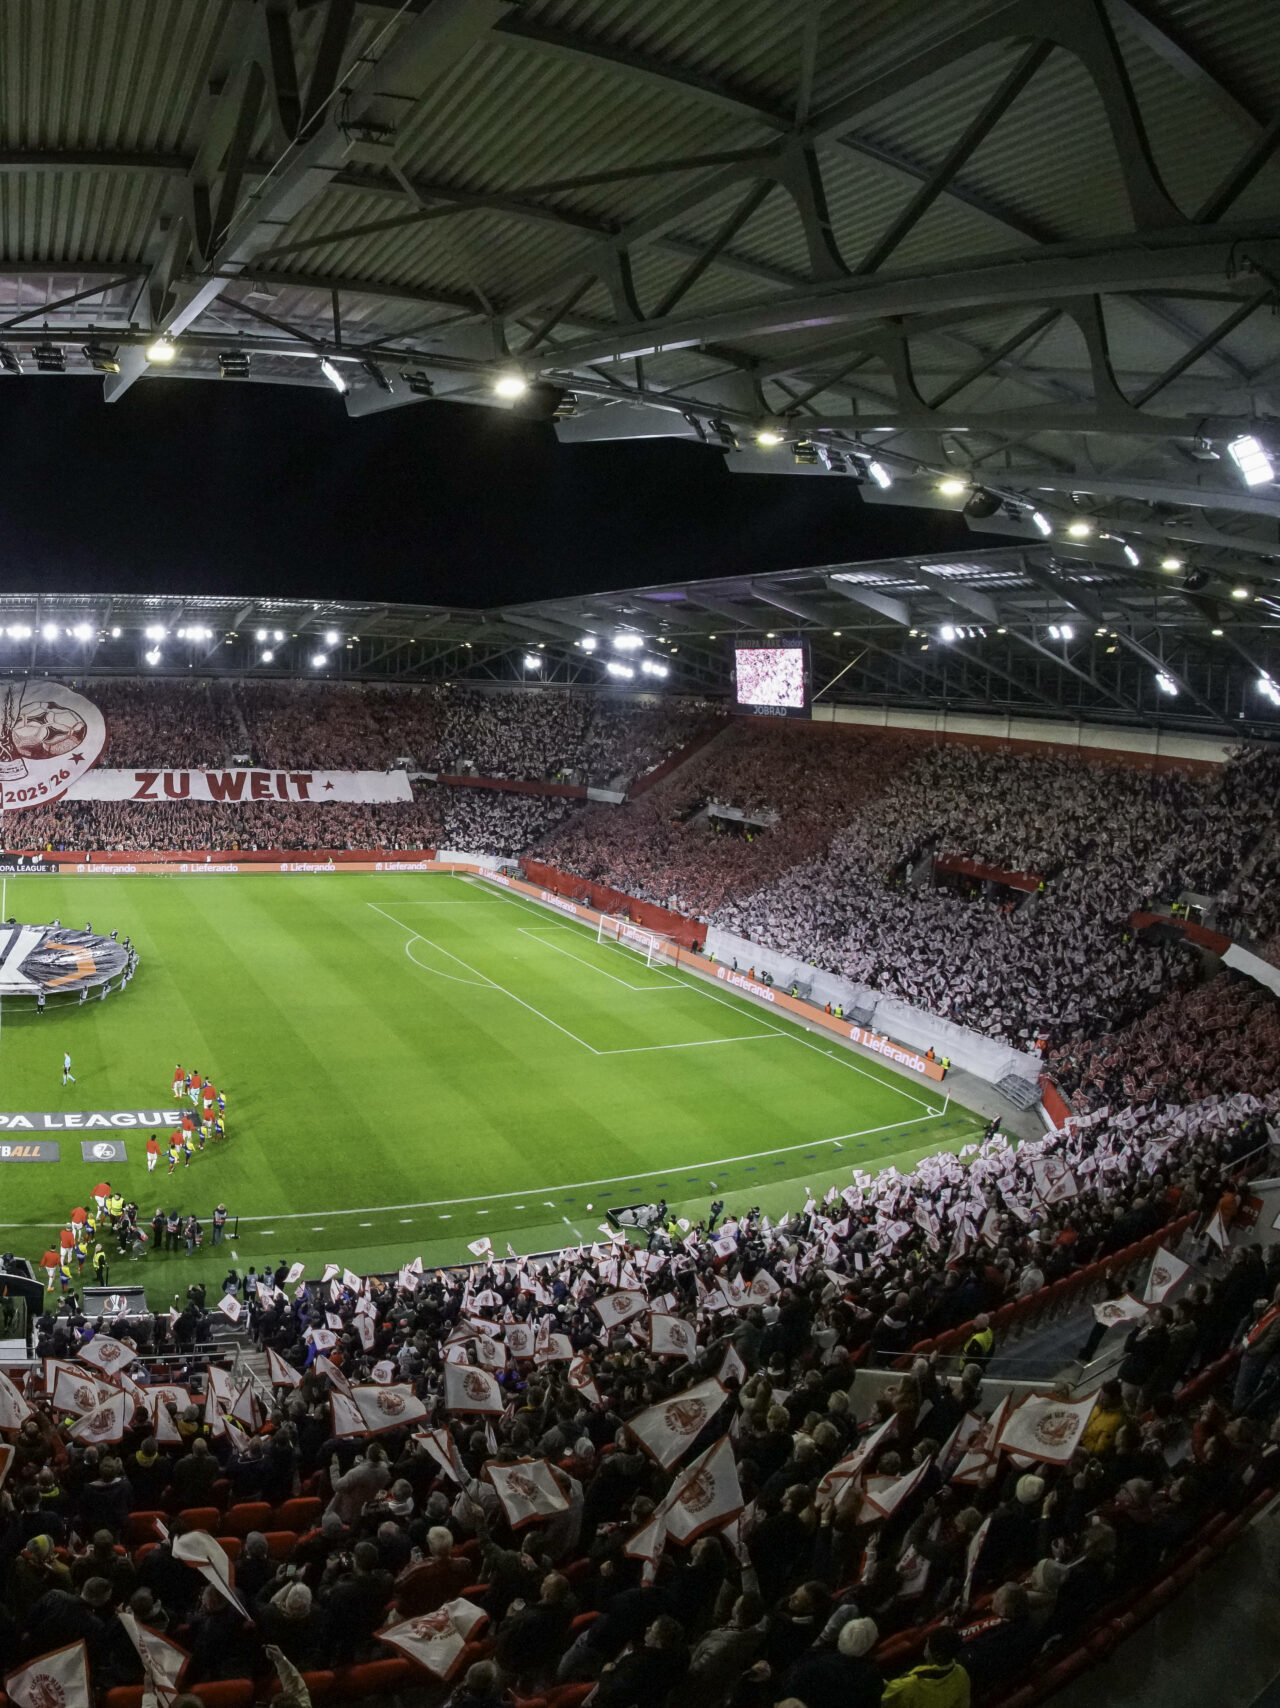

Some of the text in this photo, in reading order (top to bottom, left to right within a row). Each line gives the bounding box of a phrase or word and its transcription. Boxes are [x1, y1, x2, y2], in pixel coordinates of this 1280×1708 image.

[753, 705, 787, 716] JOBRAD
[4, 769, 71, 803] 2025/26
[134, 771, 314, 801] ZU WEIT
[87, 863, 136, 873] Lieferando
[191, 863, 238, 873] Lieferando
[290, 862, 335, 873] Lieferando
[384, 862, 427, 872] Lieferando
[726, 970, 775, 1002] Lieferando
[862, 1031, 926, 1073] Lieferando
[43, 1111, 184, 1128] LEAGUE
